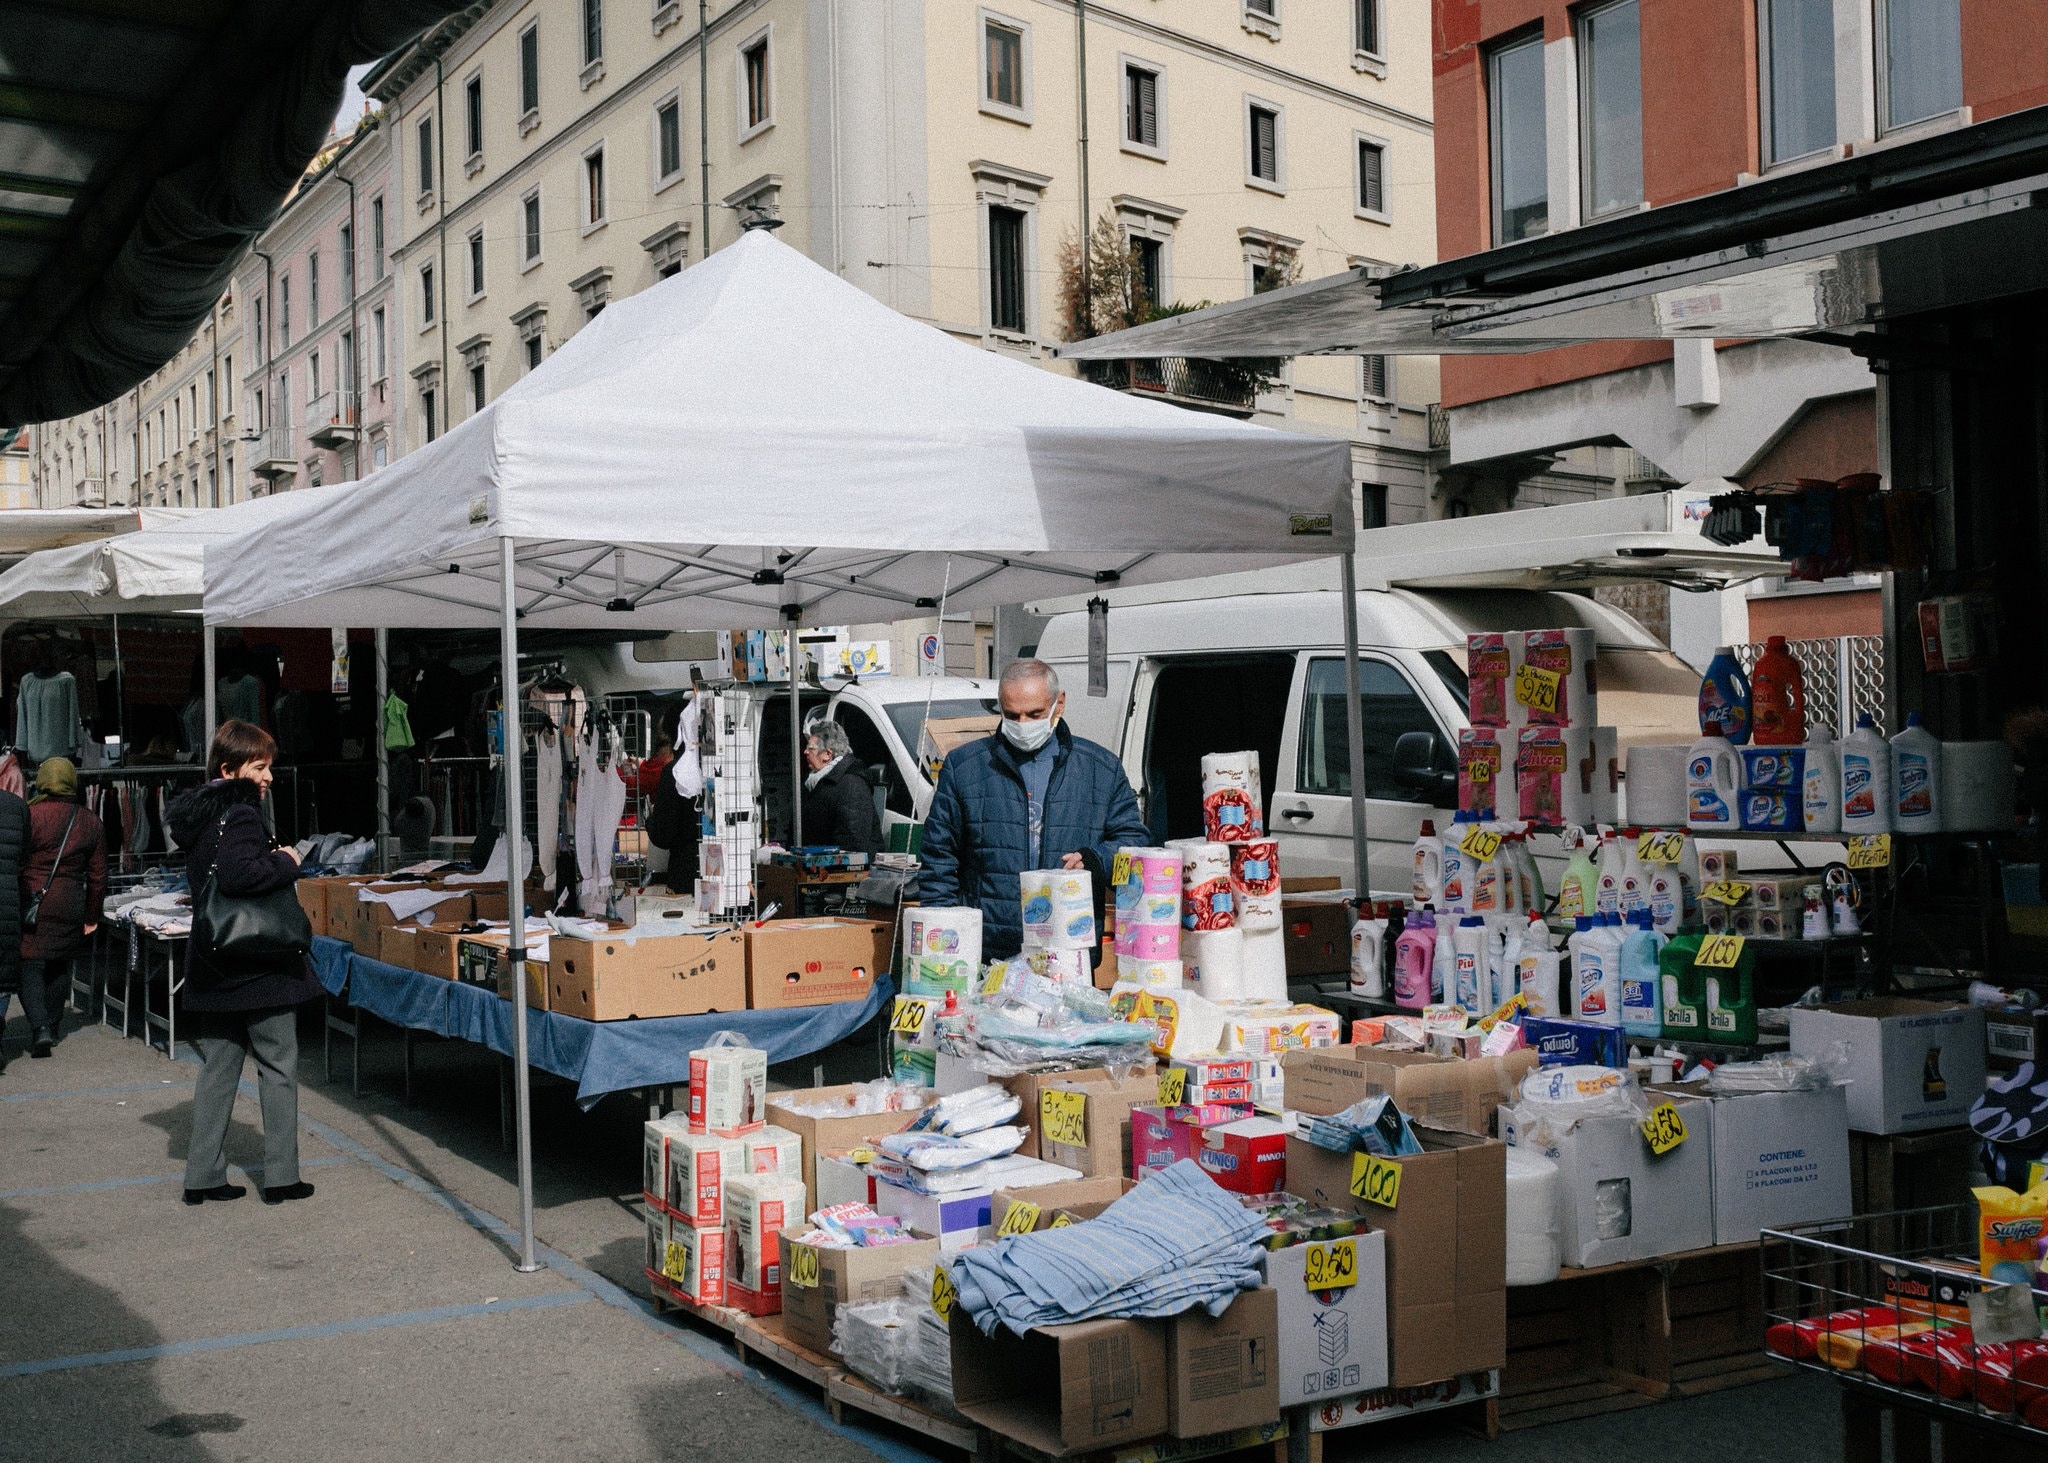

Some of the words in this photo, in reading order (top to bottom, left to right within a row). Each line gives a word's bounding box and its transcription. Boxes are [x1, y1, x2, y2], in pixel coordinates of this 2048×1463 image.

[1708, 706, 1730, 721] ACE
[1519, 744, 1562, 767] Chicca
[1849, 848, 1889, 867] OFFERTA
[1668, 1010, 1691, 1023] Brilla
[1710, 1013, 1730, 1027] Brilla
[1543, 1034, 1578, 1052] Tempo
[1200, 1149, 1237, 1170] L'UNICO
[1760, 1167, 1792, 1177] FLACONI
[1760, 1177, 1792, 1187] FLACONI
[1986, 1222, 2042, 1241] Swiffer
